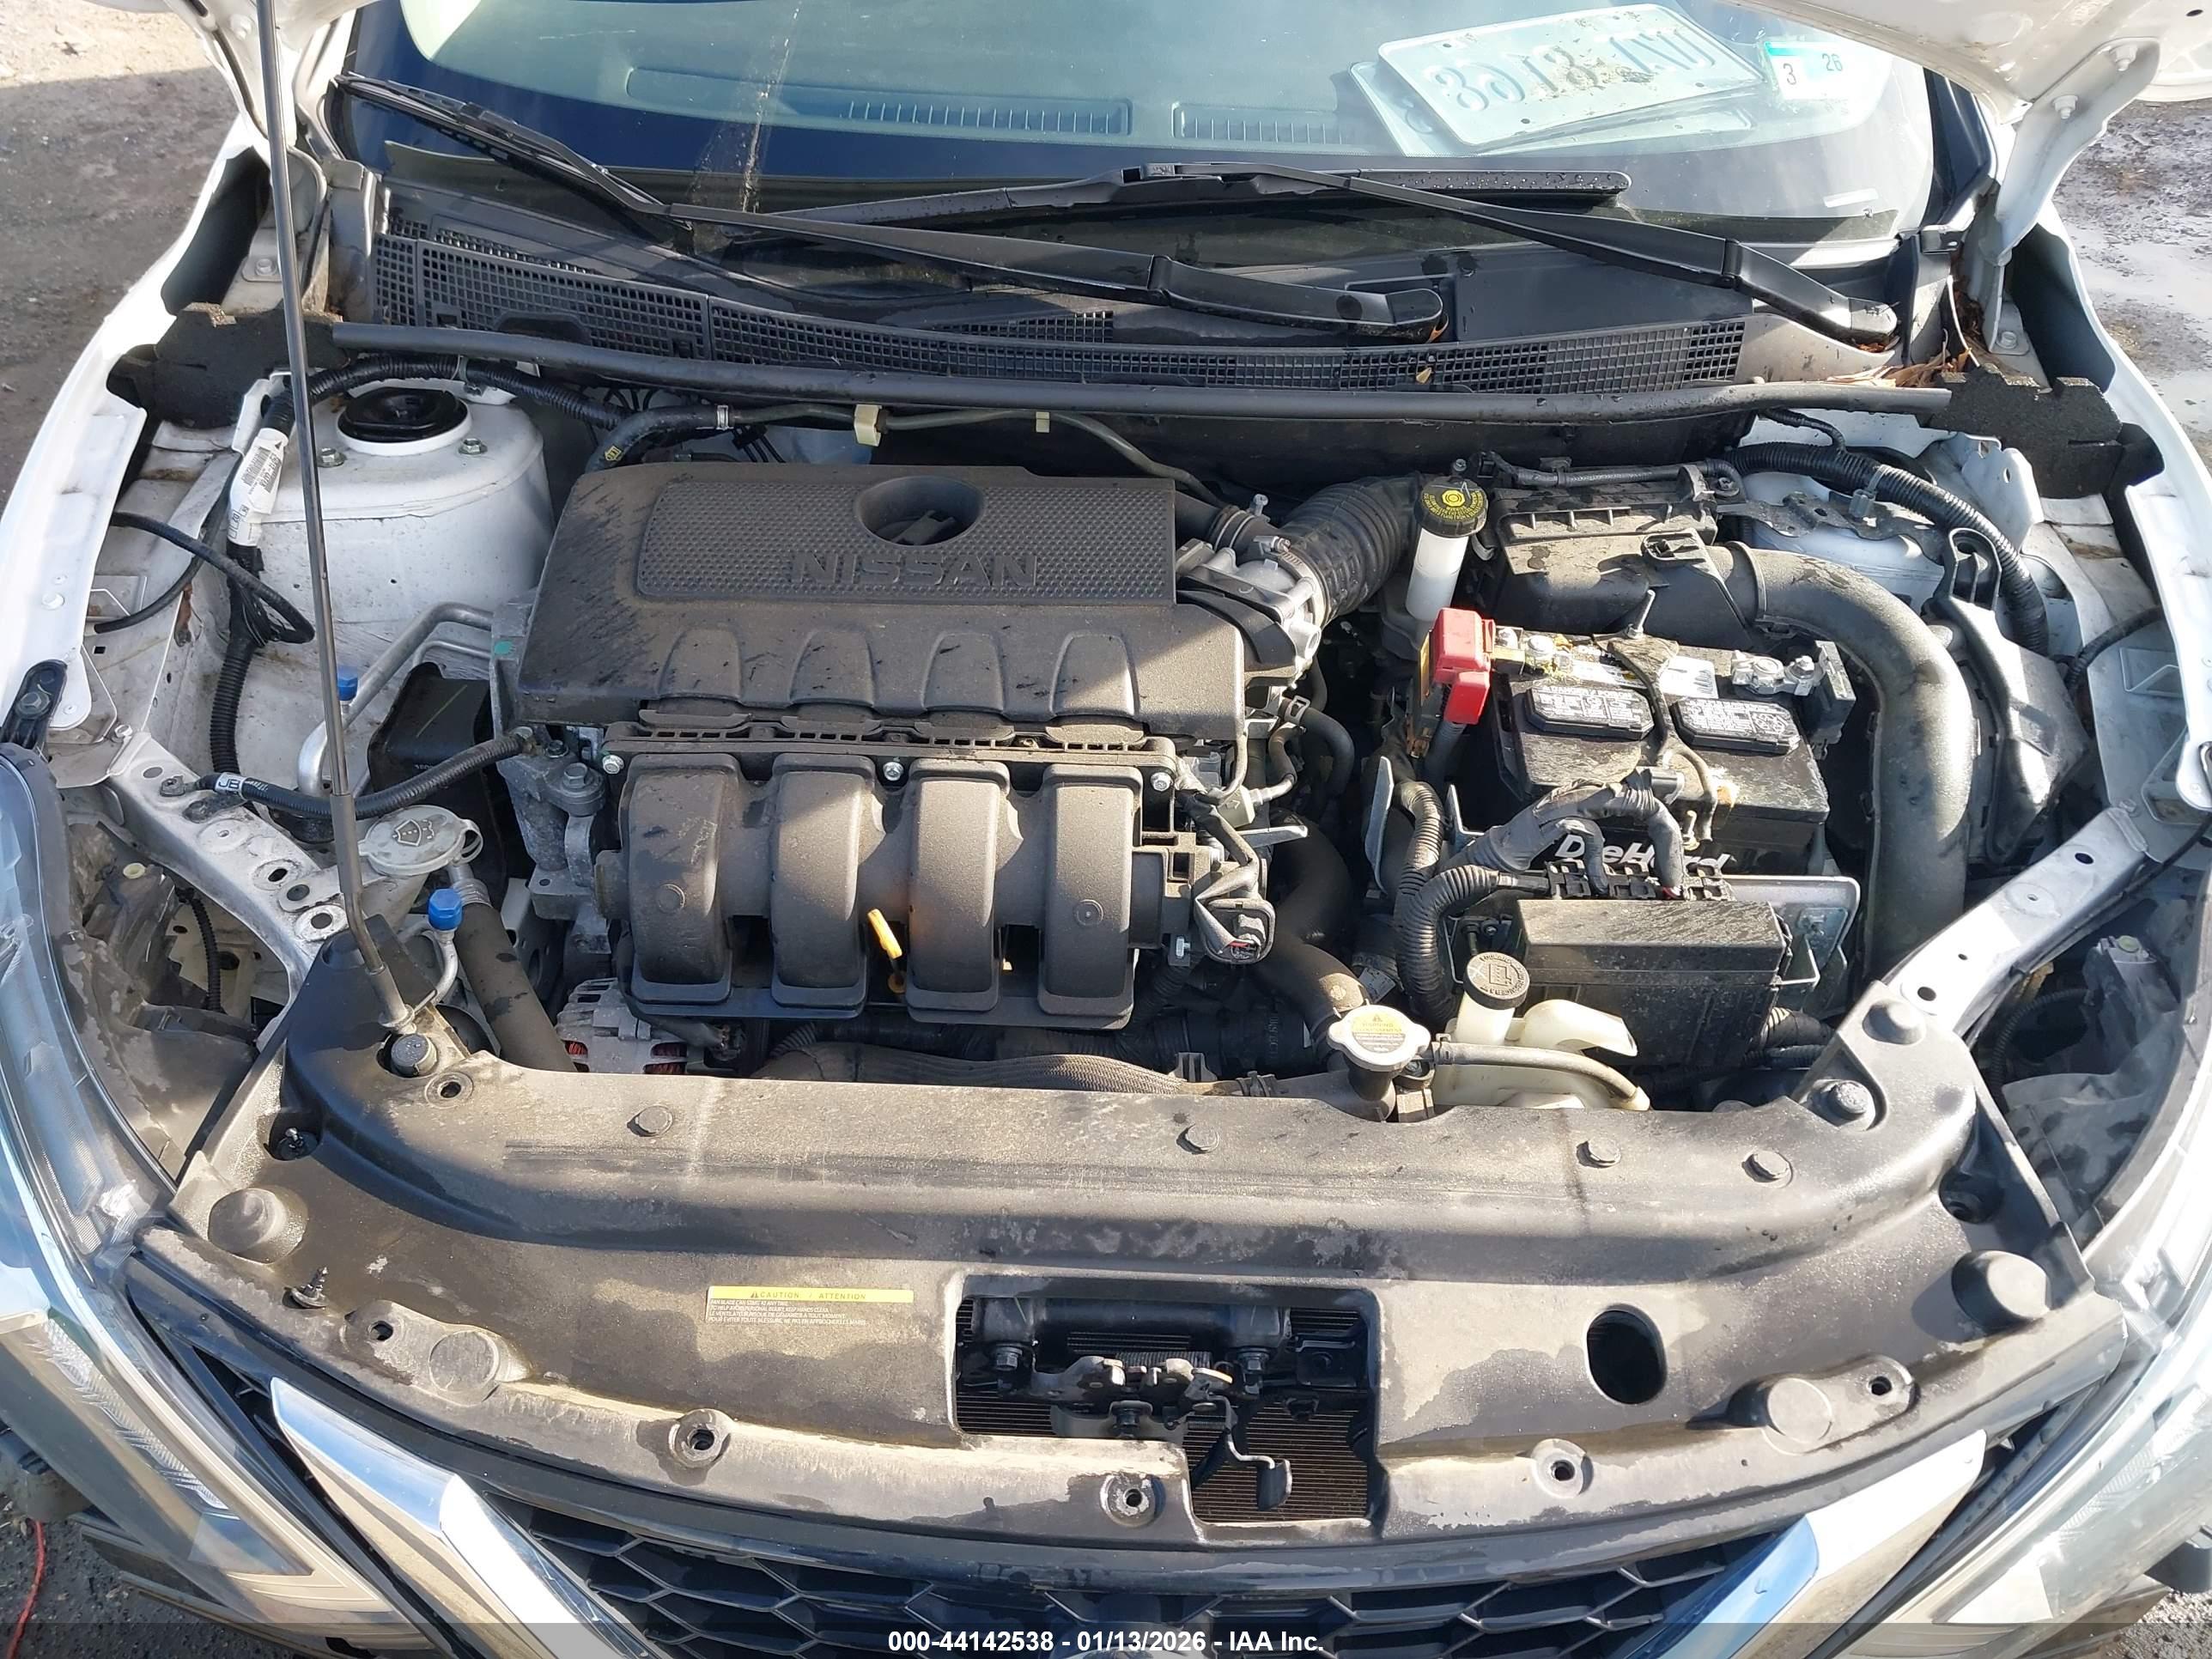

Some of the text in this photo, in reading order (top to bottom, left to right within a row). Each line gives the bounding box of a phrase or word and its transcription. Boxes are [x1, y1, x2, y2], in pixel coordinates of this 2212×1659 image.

[1782, 62, 1797, 86] 3
[1821, 52, 1844, 72] 26
[790, 550, 1038, 586] NISSAN
